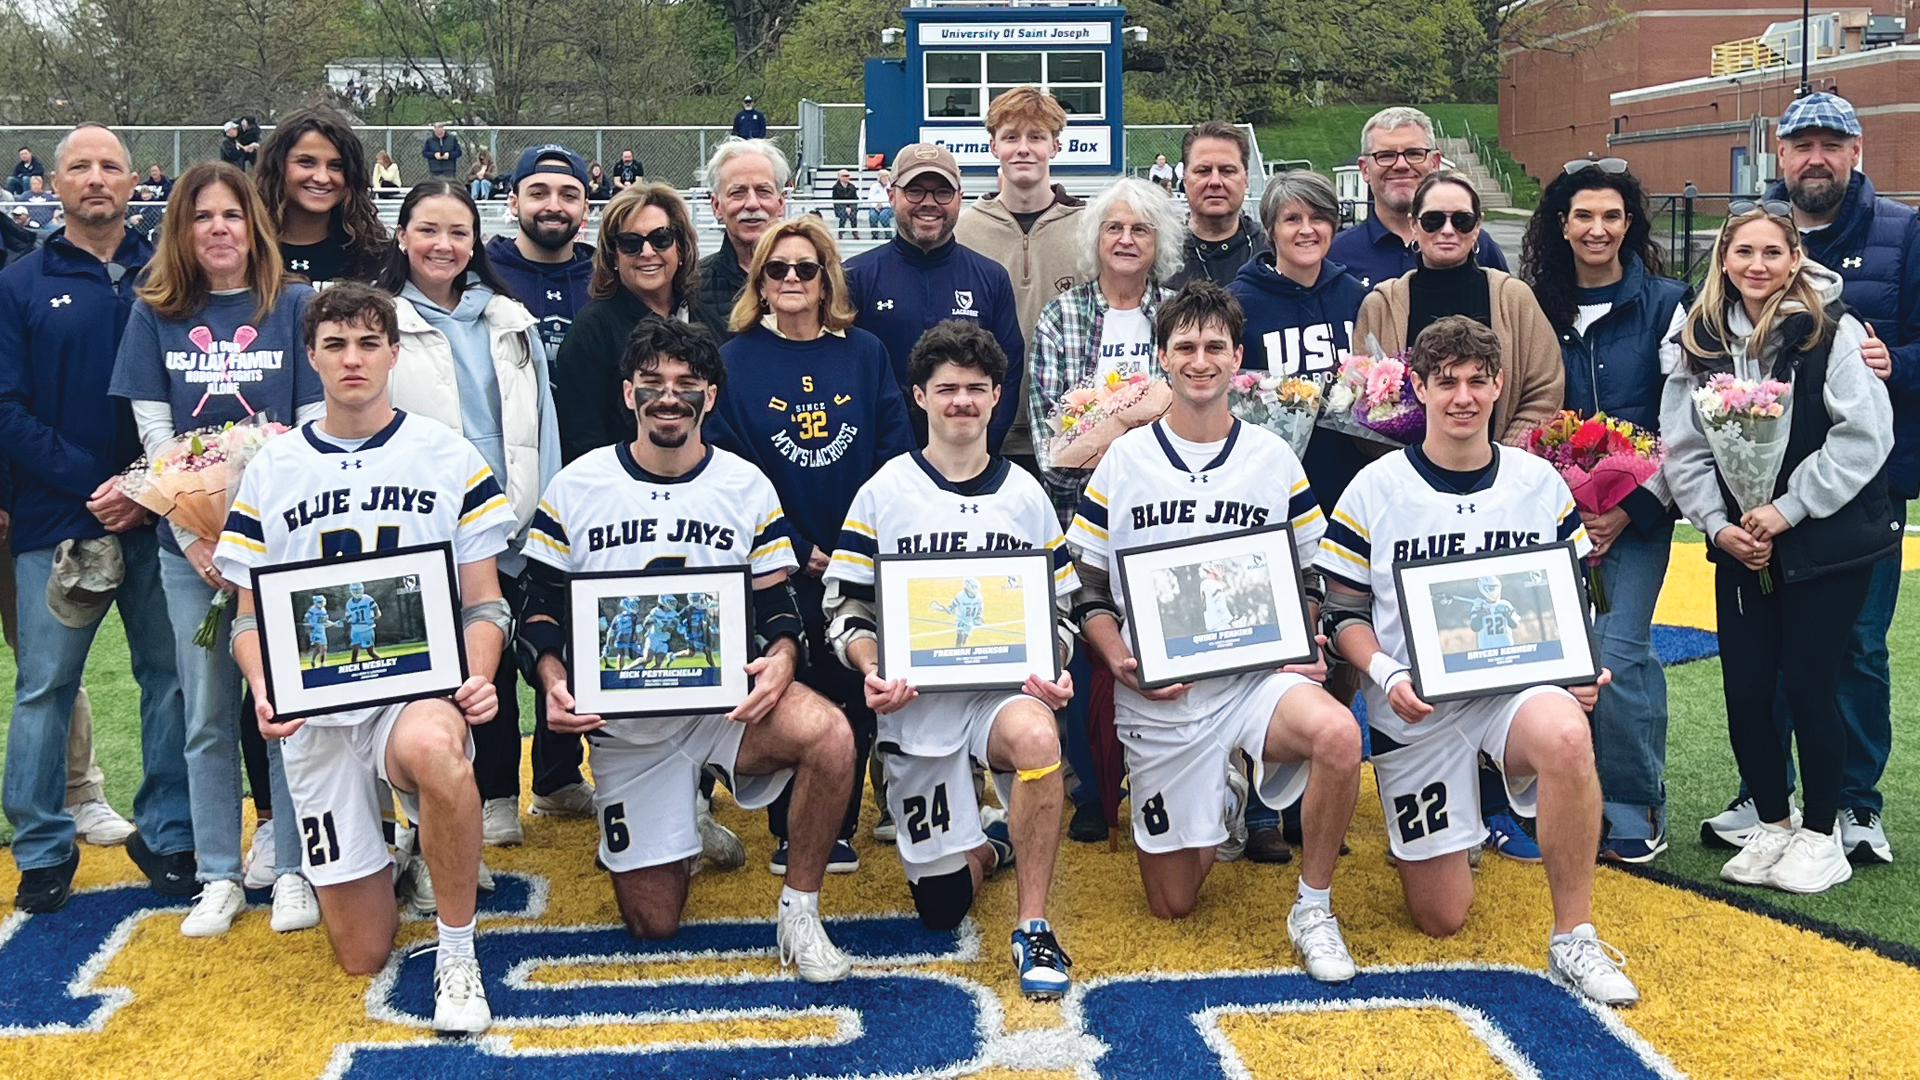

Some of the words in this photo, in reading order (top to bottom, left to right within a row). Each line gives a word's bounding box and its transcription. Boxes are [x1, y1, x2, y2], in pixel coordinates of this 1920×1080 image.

[941, 28, 1000, 40] University
[1018, 28, 1047, 38] Saint
[1050, 28, 1090, 40] Joseph
[1068, 139, 1098, 152] Box
[219, 340, 240, 353] OUR
[1262, 320, 1354, 378] USJ
[165, 351, 197, 370] USJ
[199, 353, 226, 371] LAX
[228, 350, 284, 369] FAMILY
[185, 370, 224, 383] NOBODY
[227, 369, 263, 381] FIGHTS
[207, 382, 240, 394] ALONE
[795, 402, 826, 412] SINCE
[770, 429, 809, 467] MEN'S
[809, 422, 858, 467] LACROSSE
[283, 488, 351, 532] BLUE
[361, 486, 437, 514] JAYS
[1131, 500, 1197, 530] BLUE
[1206, 500, 1270, 527] JAYS
[588, 518, 658, 552] BLUE
[667, 518, 735, 550] JAYS
[897, 531, 968, 554] BLUE
[1393, 533, 1465, 562] BLUE
[1485, 616, 1505, 636] 22
[972, 646, 1009, 655] JOHNSON
[338, 663, 360, 674] NICK
[361, 657, 398, 670] WESLEY
[619, 670, 640, 679] NICK
[903, 782, 950, 844] 24
[1141, 791, 1170, 836] 8
[1393, 781, 1449, 844] 22
[301, 810, 340, 867] 21
[603, 802, 630, 853] 6
